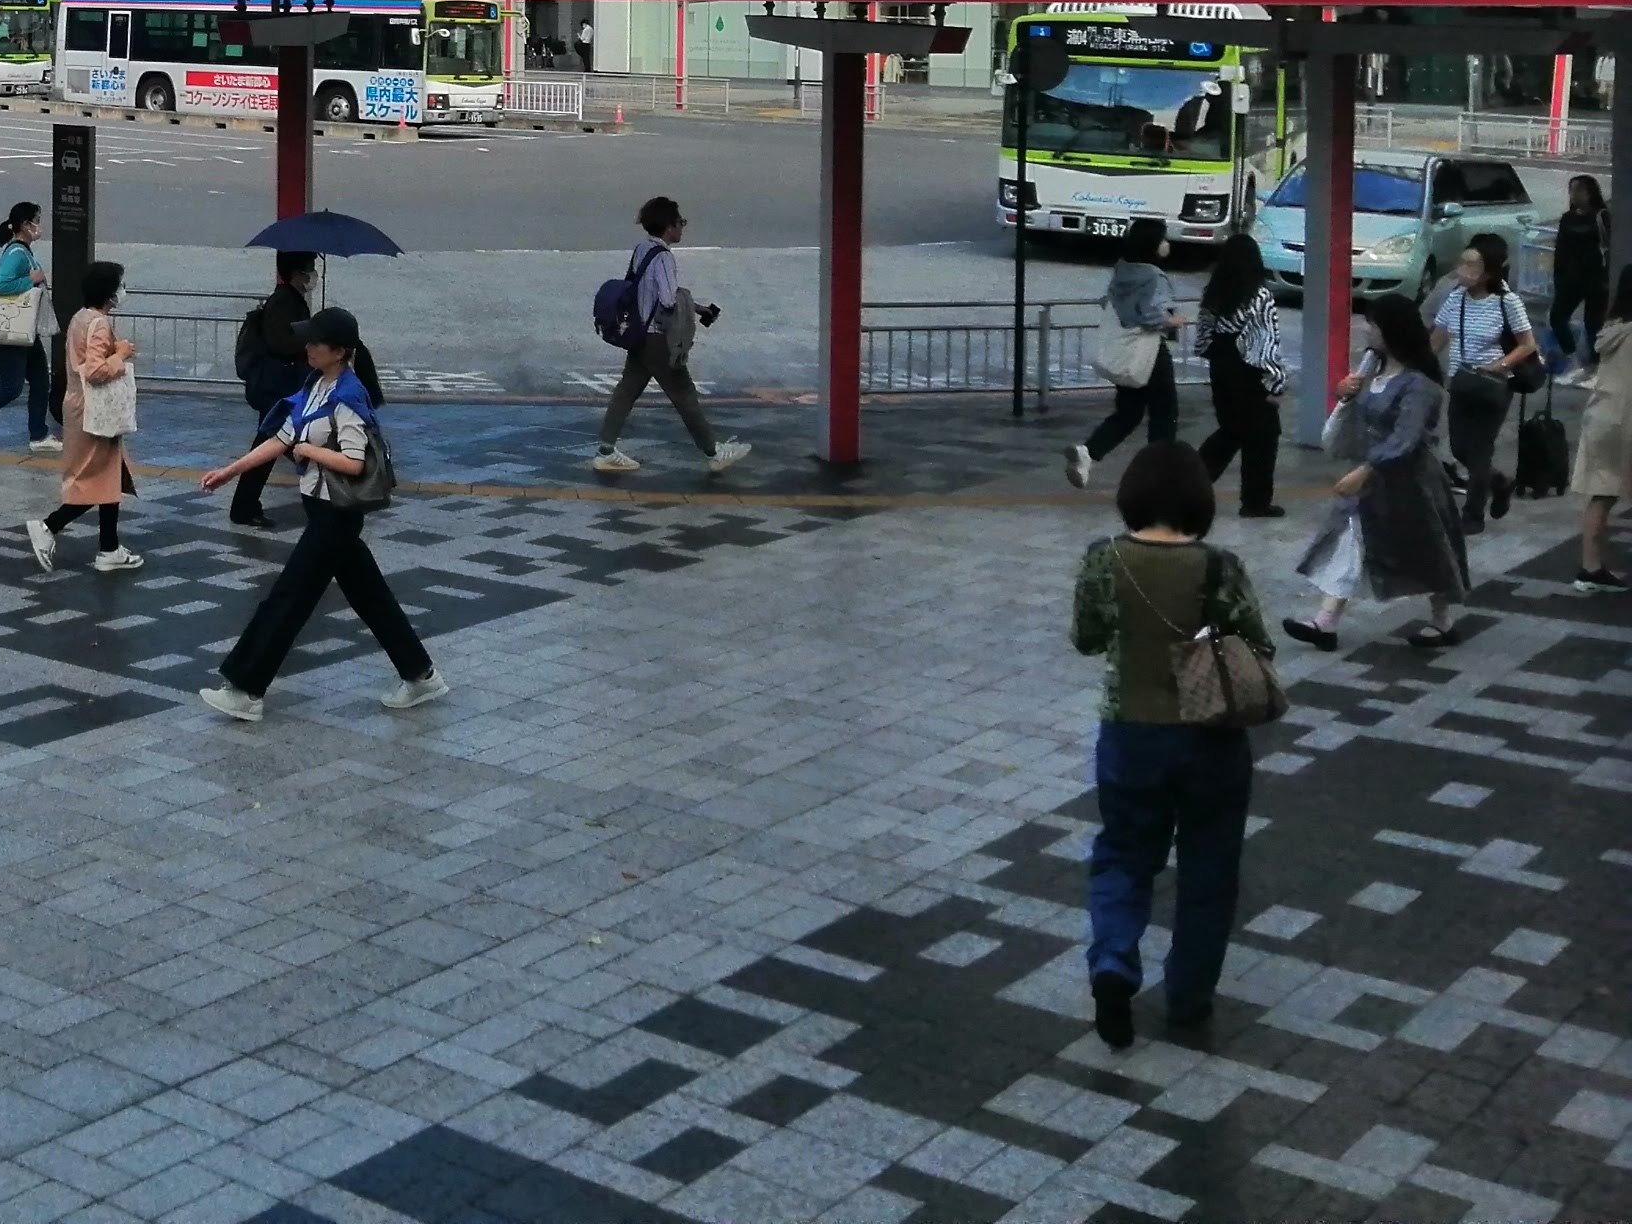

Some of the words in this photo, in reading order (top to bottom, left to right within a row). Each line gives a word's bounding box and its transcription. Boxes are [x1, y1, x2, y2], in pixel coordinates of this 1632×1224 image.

[365, 87, 418, 103] 県内最大
[365, 103, 418, 119] スケール
[1092, 222, 1127, 236] 30-87
